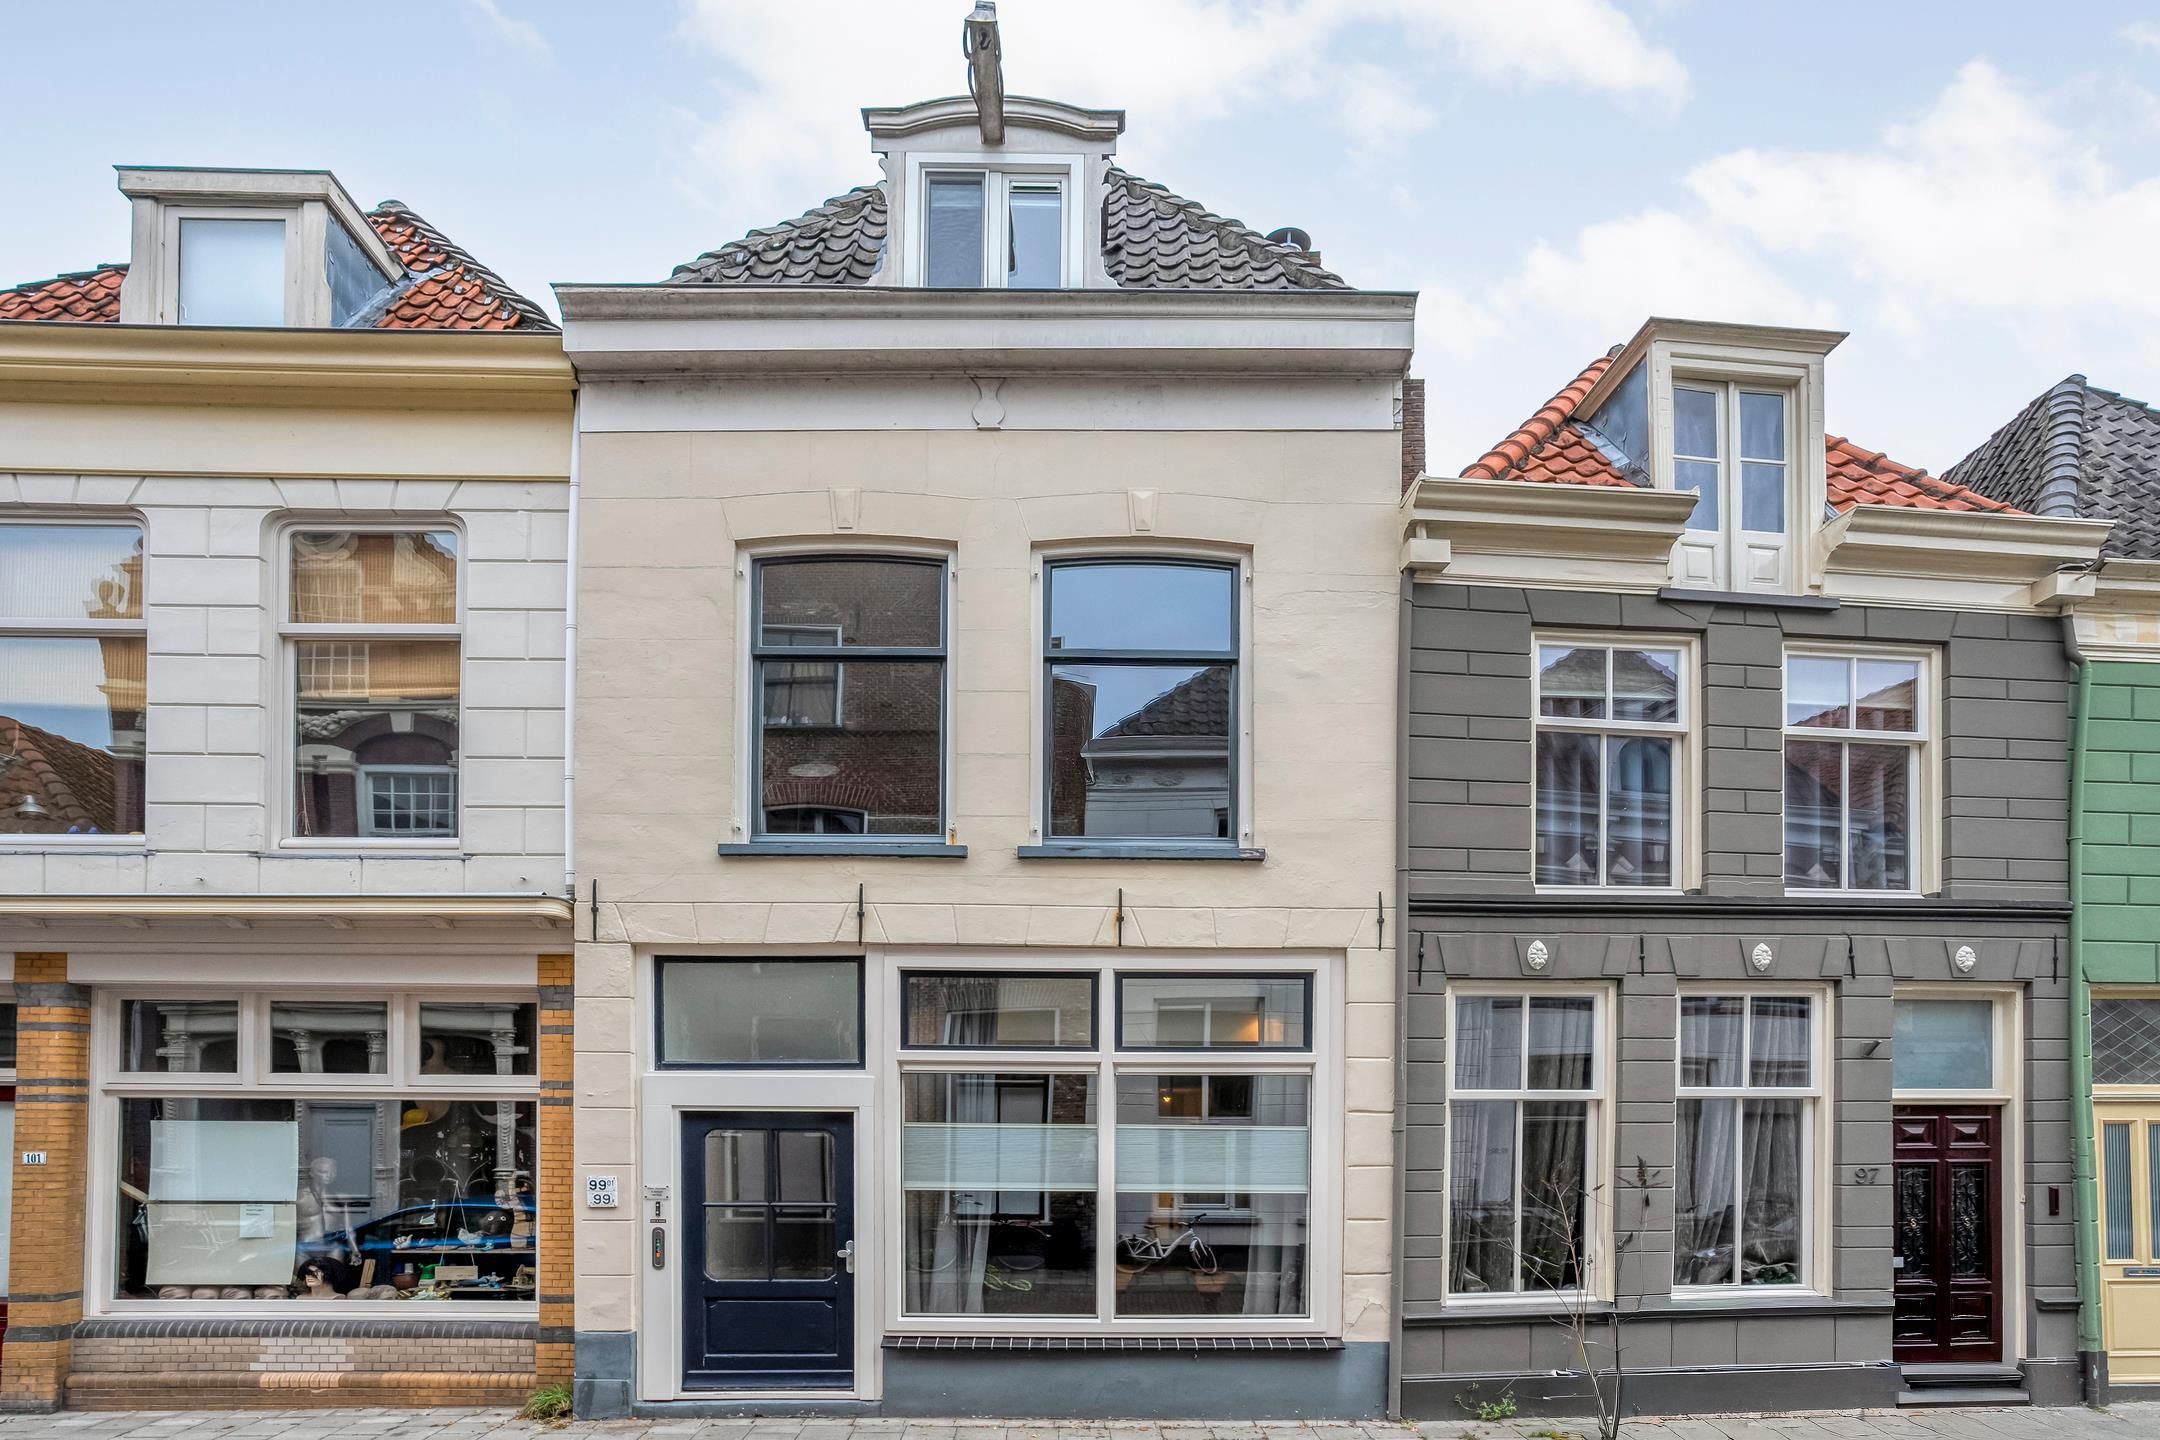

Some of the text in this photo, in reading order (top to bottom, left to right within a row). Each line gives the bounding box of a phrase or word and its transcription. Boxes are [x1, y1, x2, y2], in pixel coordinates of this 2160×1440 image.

[26, 1153, 41, 1164] 101
[1855, 1168, 1879, 1184] 97
[593, 1194, 611, 1205] 99
